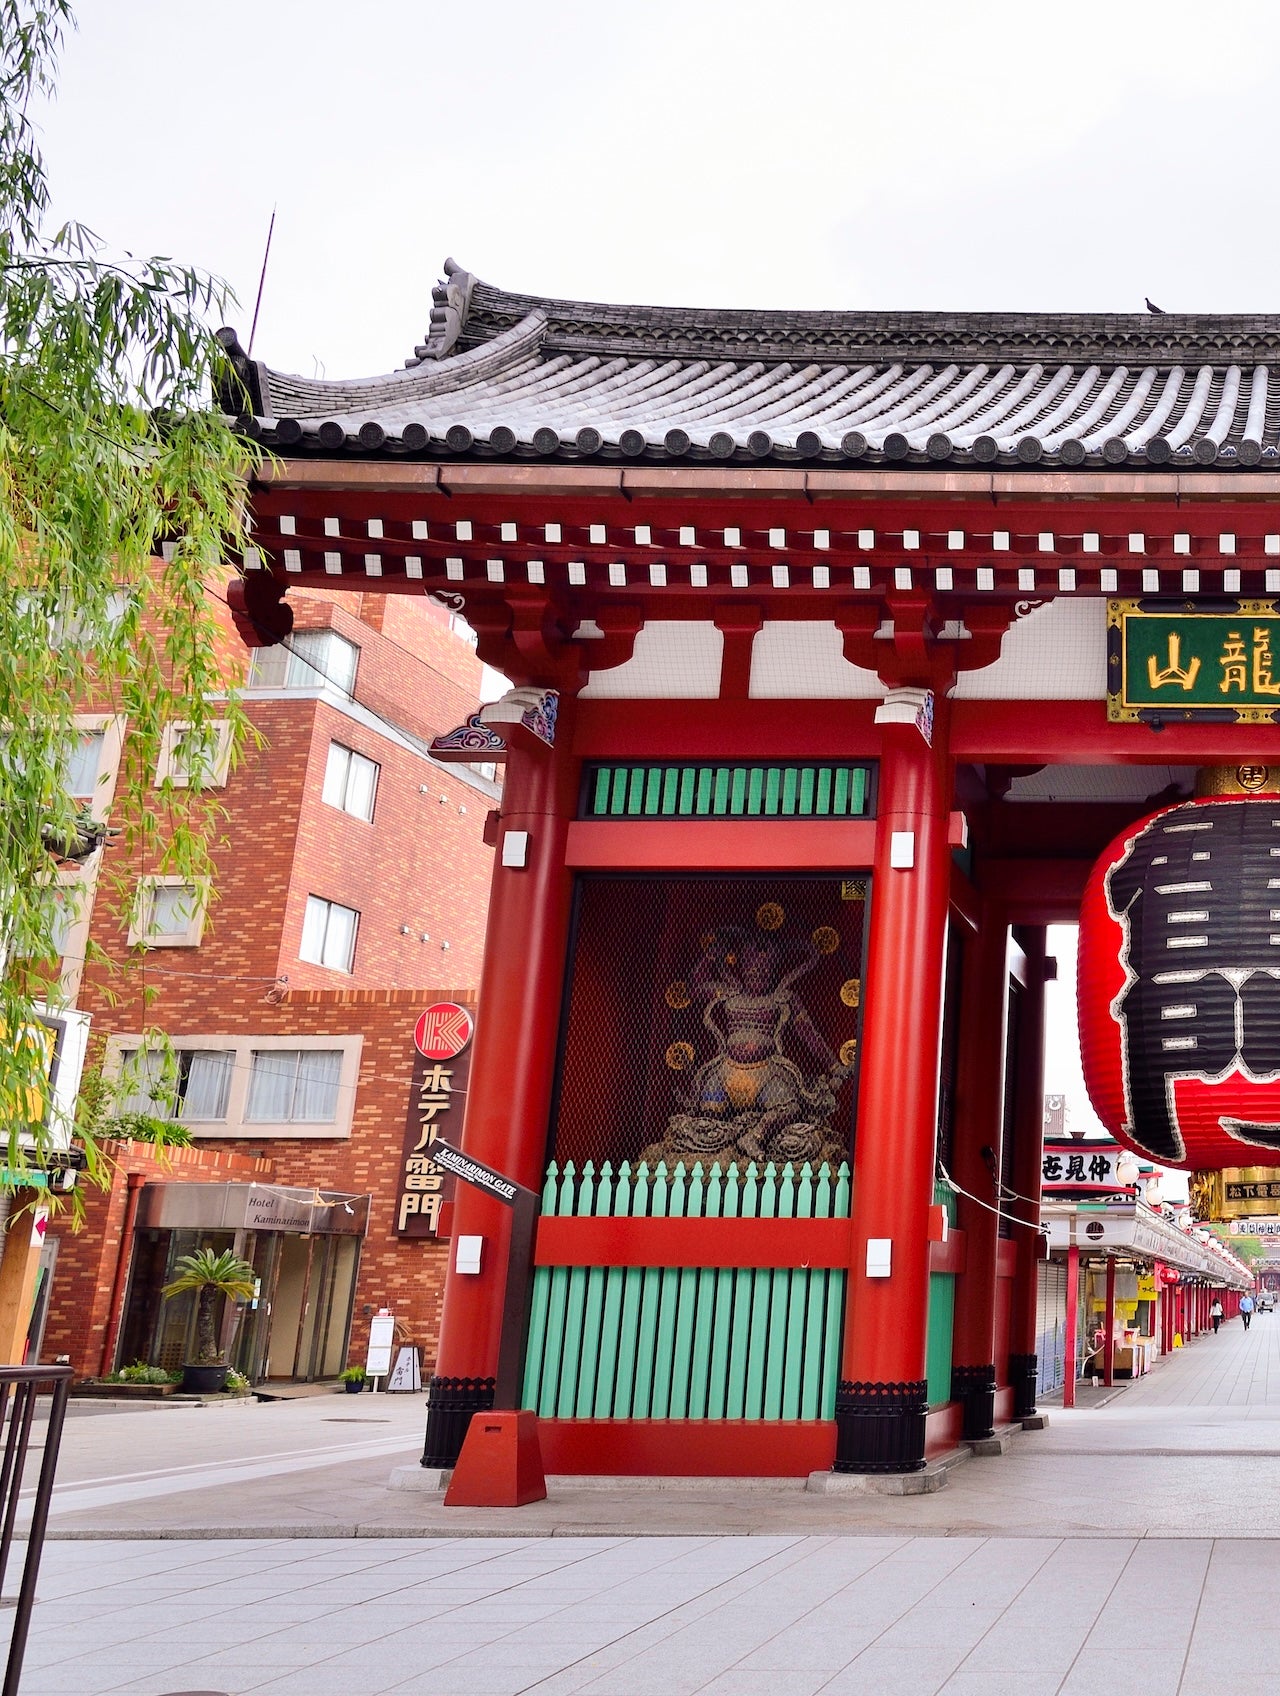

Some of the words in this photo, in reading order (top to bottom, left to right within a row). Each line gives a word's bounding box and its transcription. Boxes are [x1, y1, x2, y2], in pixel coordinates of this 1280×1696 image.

[440, 1148, 497, 1184] KAMINARIMON
[494, 1179, 517, 1195] GATE
[248, 1197, 275, 1208] Hotel
[253, 1215, 311, 1227] Kaminarimon
